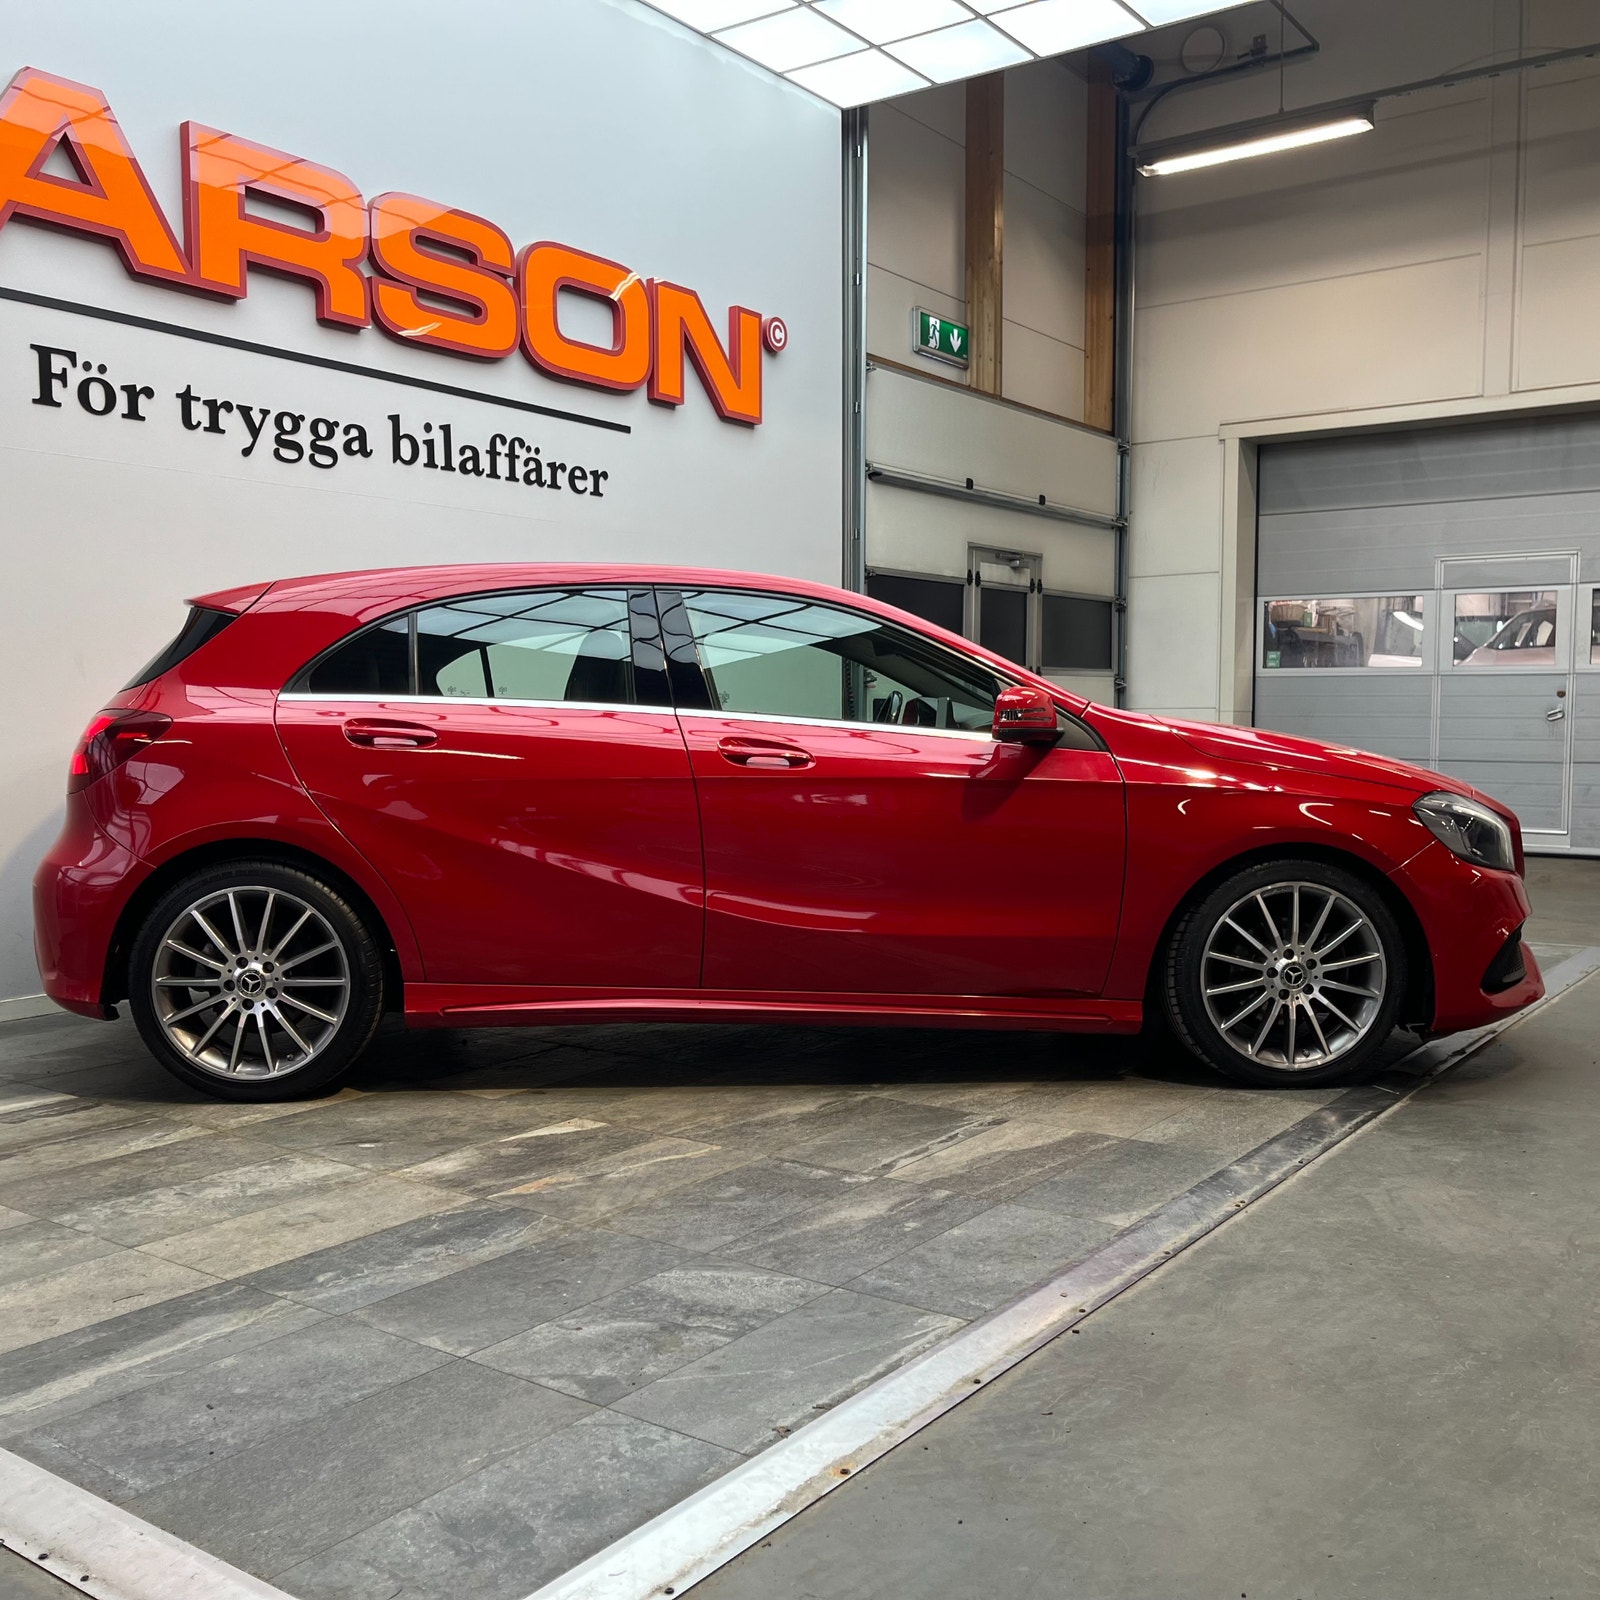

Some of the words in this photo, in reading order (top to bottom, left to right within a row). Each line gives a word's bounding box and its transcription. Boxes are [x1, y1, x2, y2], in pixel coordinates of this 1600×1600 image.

[30, 344, 154, 421] För
[176, 385, 373, 468] trygga
[388, 415, 608, 497] bilaffärer
